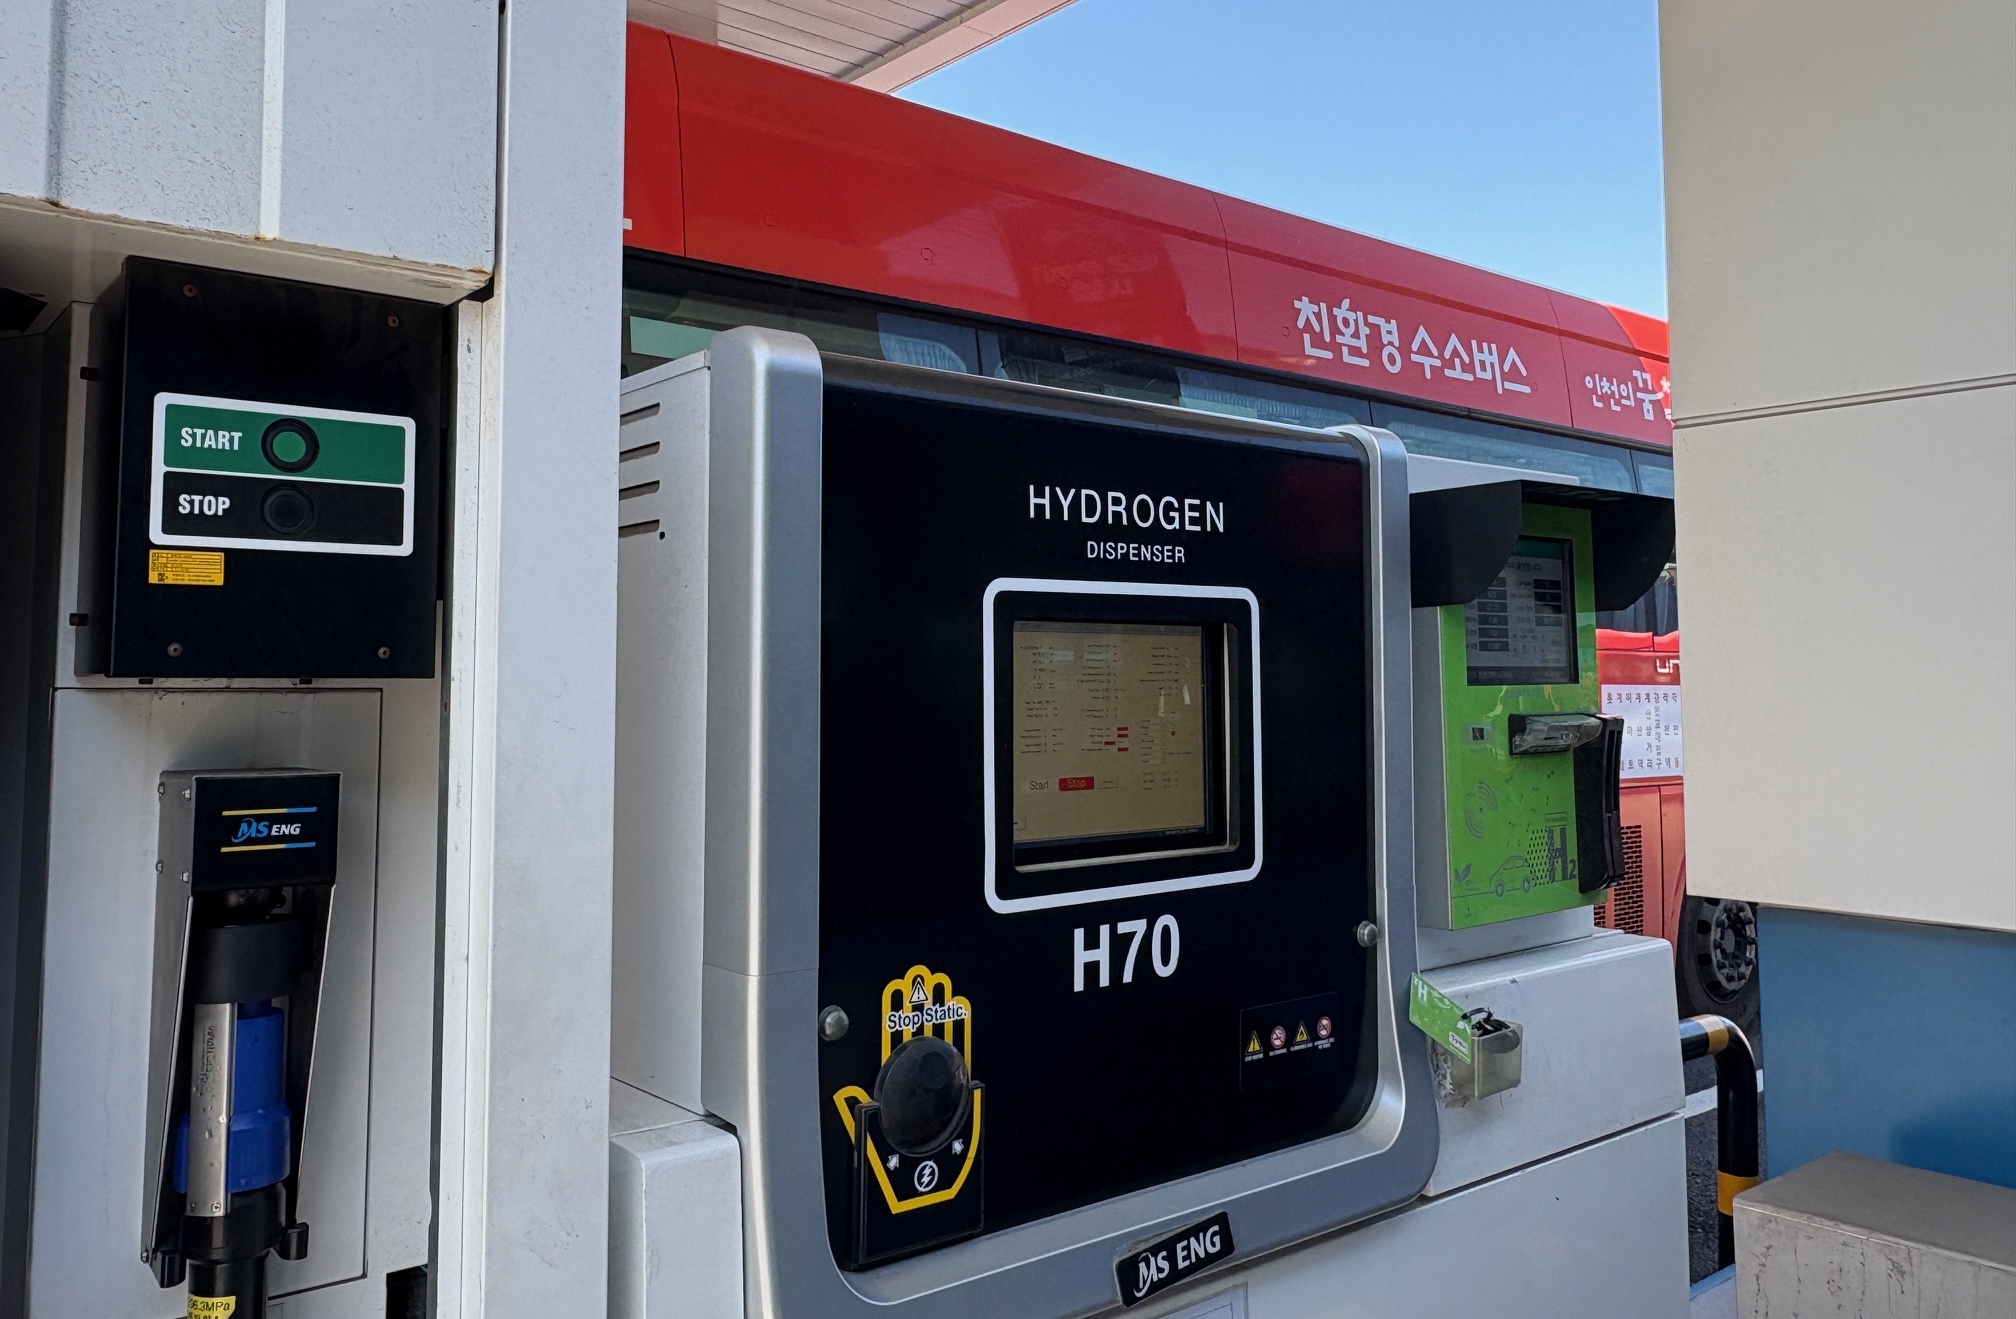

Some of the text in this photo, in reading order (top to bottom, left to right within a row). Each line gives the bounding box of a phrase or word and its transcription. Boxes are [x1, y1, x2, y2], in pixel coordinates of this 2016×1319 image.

[1293, 295, 1532, 395] 친환경 수소버스
[180, 427, 243, 451] START
[178, 494, 230, 516] STOP
[1029, 484, 1224, 533] HYDROGEN
[1087, 540, 1186, 564] DISPENSER
[231, 817, 302, 843] MS ENG
[1073, 913, 1181, 993] H70
[887, 1010, 921, 1032] Stop
[1133, 1224, 1221, 1298] MS ENG
